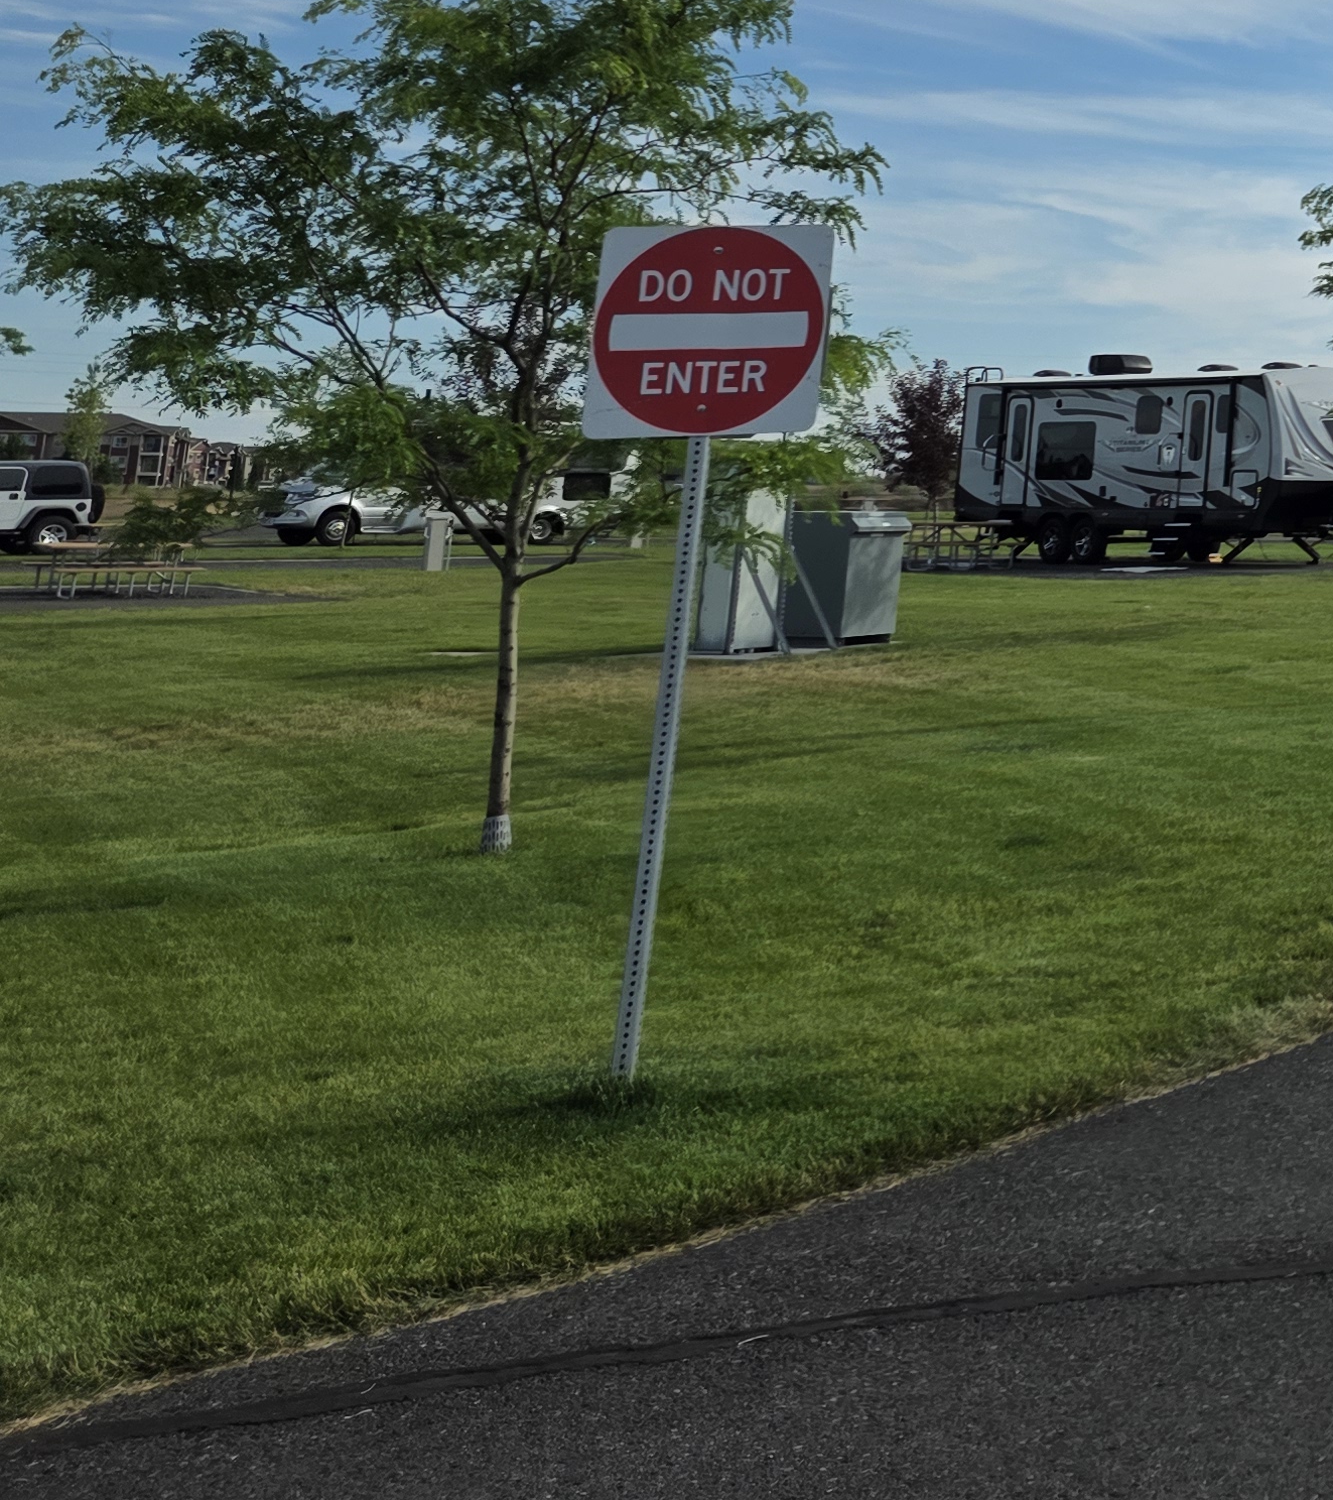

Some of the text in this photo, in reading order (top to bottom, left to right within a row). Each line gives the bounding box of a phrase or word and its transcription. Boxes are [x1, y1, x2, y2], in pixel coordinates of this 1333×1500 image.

[638, 268, 791, 302] DO NOT
[640, 360, 767, 395] ENTER
